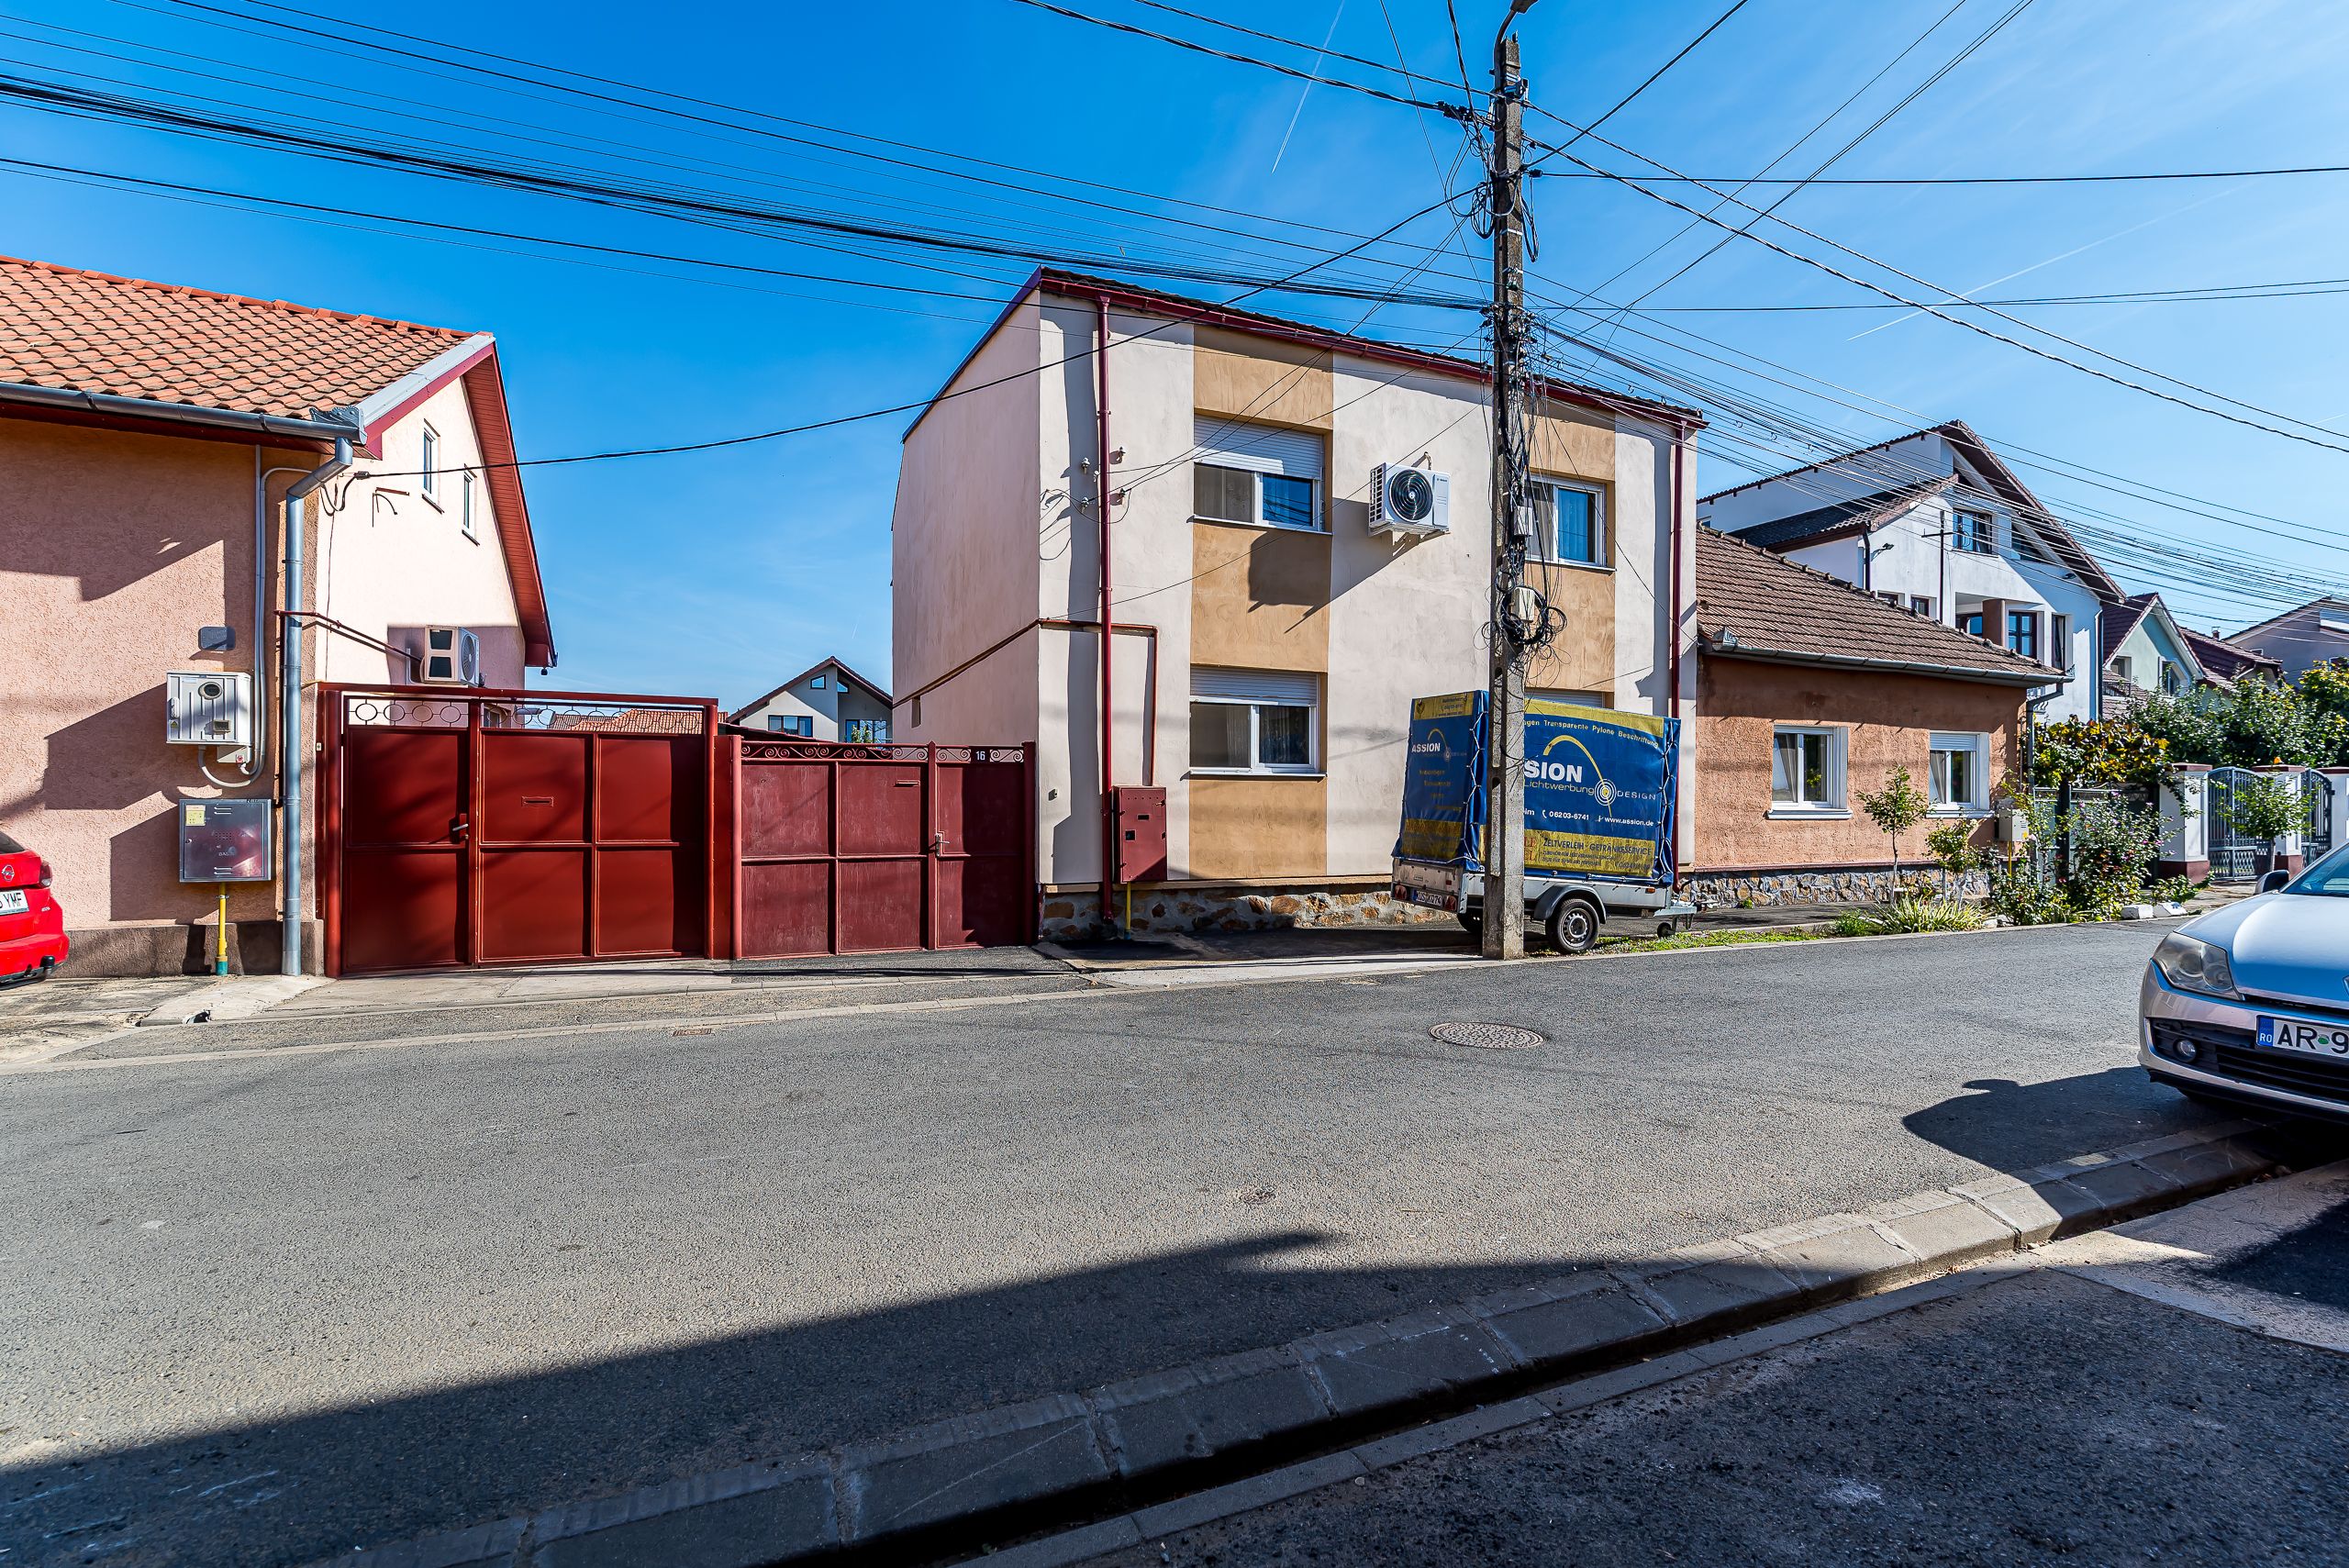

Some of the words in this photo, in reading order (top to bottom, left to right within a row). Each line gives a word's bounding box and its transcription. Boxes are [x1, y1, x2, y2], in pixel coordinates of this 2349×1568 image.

[1523, 719, 1540, 728] agen
[1592, 725, 1615, 736] Pylone
[1411, 742, 1441, 753] ASSION
[975, 751, 985, 761] 16
[1523, 760, 1583, 784] SION
[1617, 790, 1656, 801] DESIGN
[1542, 837, 1585, 850] ZELTVERLEIH
[2259, 1032, 2273, 1043] RO
[2277, 1023, 2317, 1051] AR
